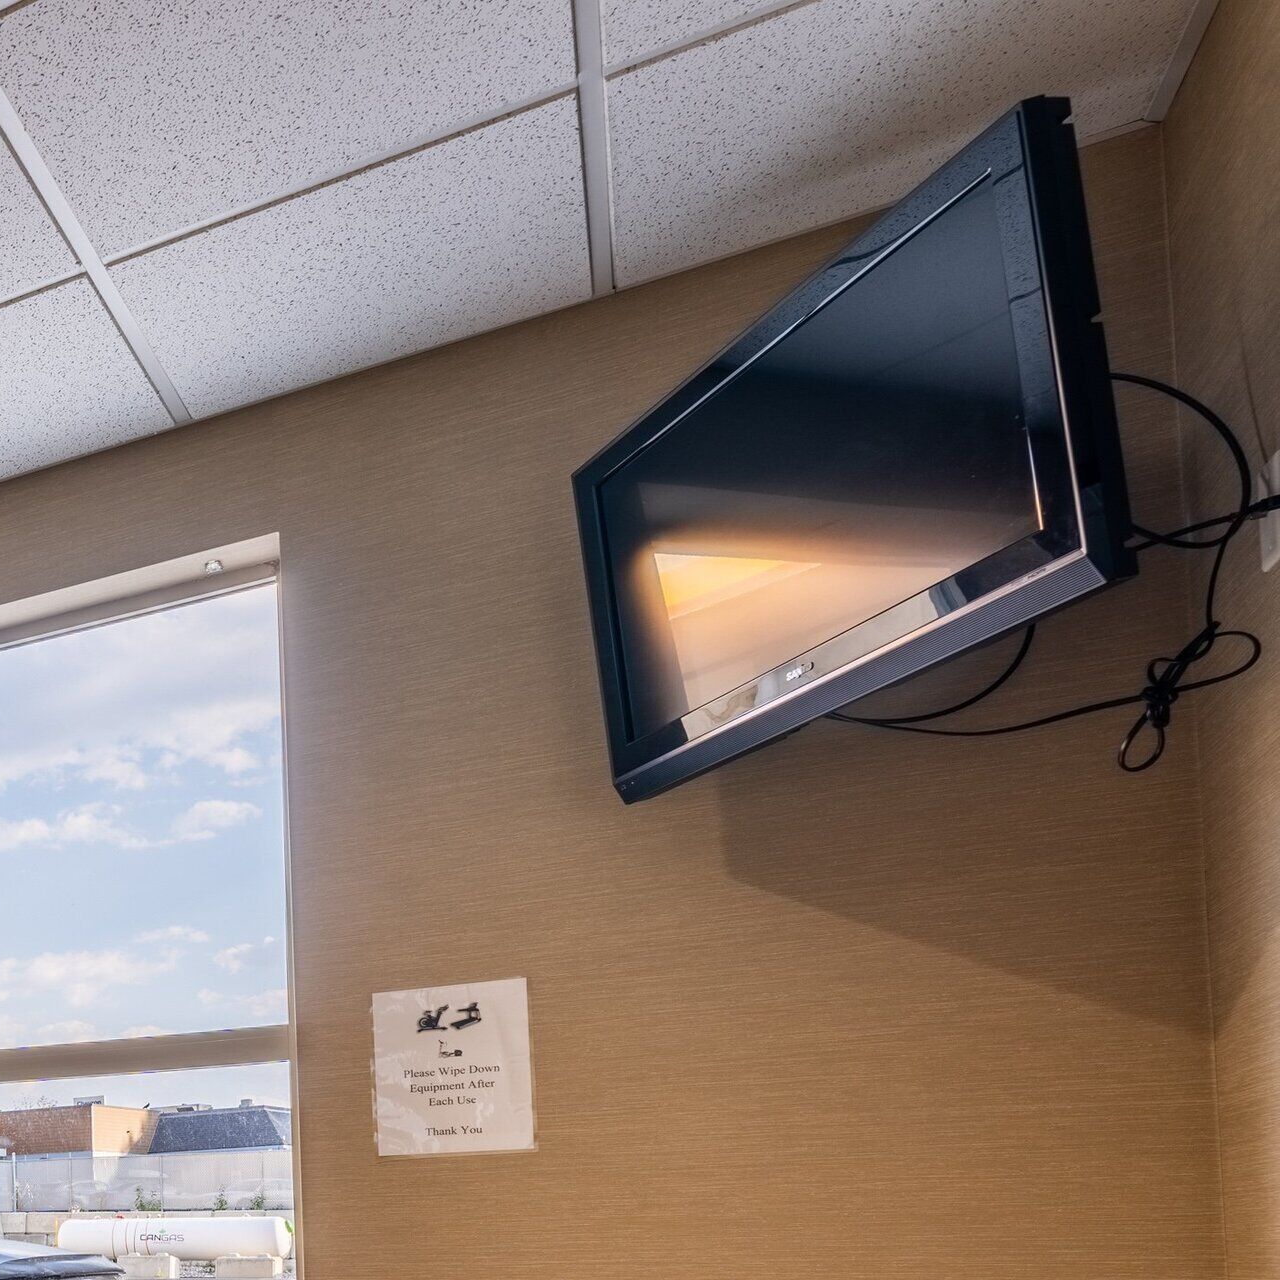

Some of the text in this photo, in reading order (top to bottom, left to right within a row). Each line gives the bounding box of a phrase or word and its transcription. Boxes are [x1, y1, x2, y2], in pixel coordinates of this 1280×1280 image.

[403, 1064, 500, 1079] Please Wipe Down
[410, 1080, 496, 1094] Equipment After
[429, 1095, 477, 1106] Each Use
[425, 1125, 483, 1136] Thank You
[140, 1234, 185, 1242] CANGAS
